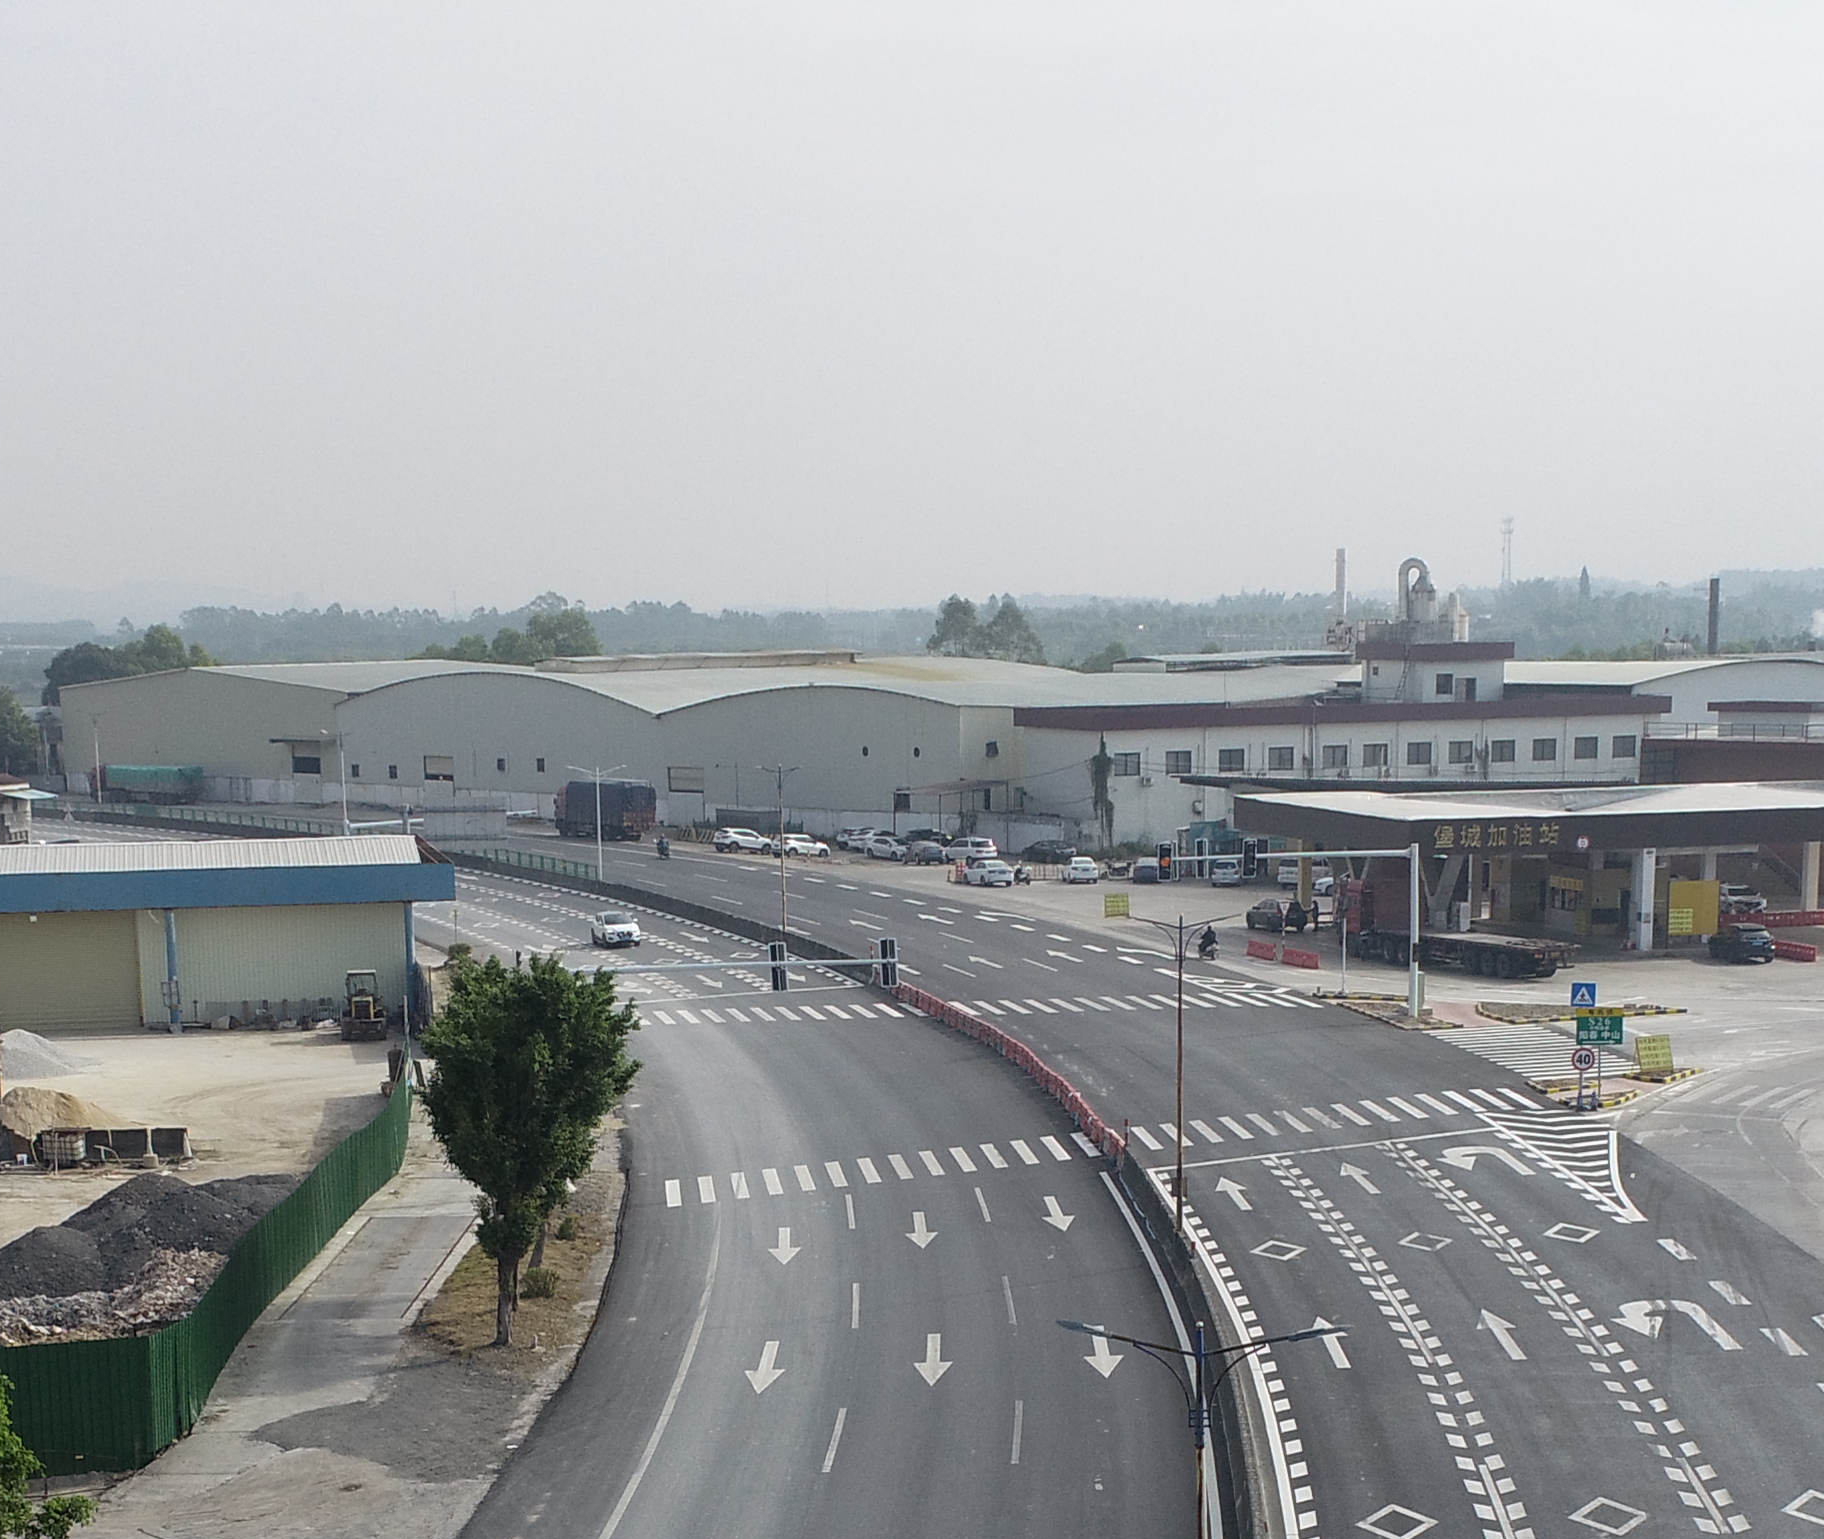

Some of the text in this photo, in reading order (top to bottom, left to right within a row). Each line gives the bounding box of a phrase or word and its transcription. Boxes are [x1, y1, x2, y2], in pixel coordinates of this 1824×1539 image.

[1433, 822, 1560, 849] 堡城加油站
[1588, 1017, 1612, 1026] S26
[1600, 1029, 1621, 1040] 中山
[1575, 1053, 1591, 1066] 40
